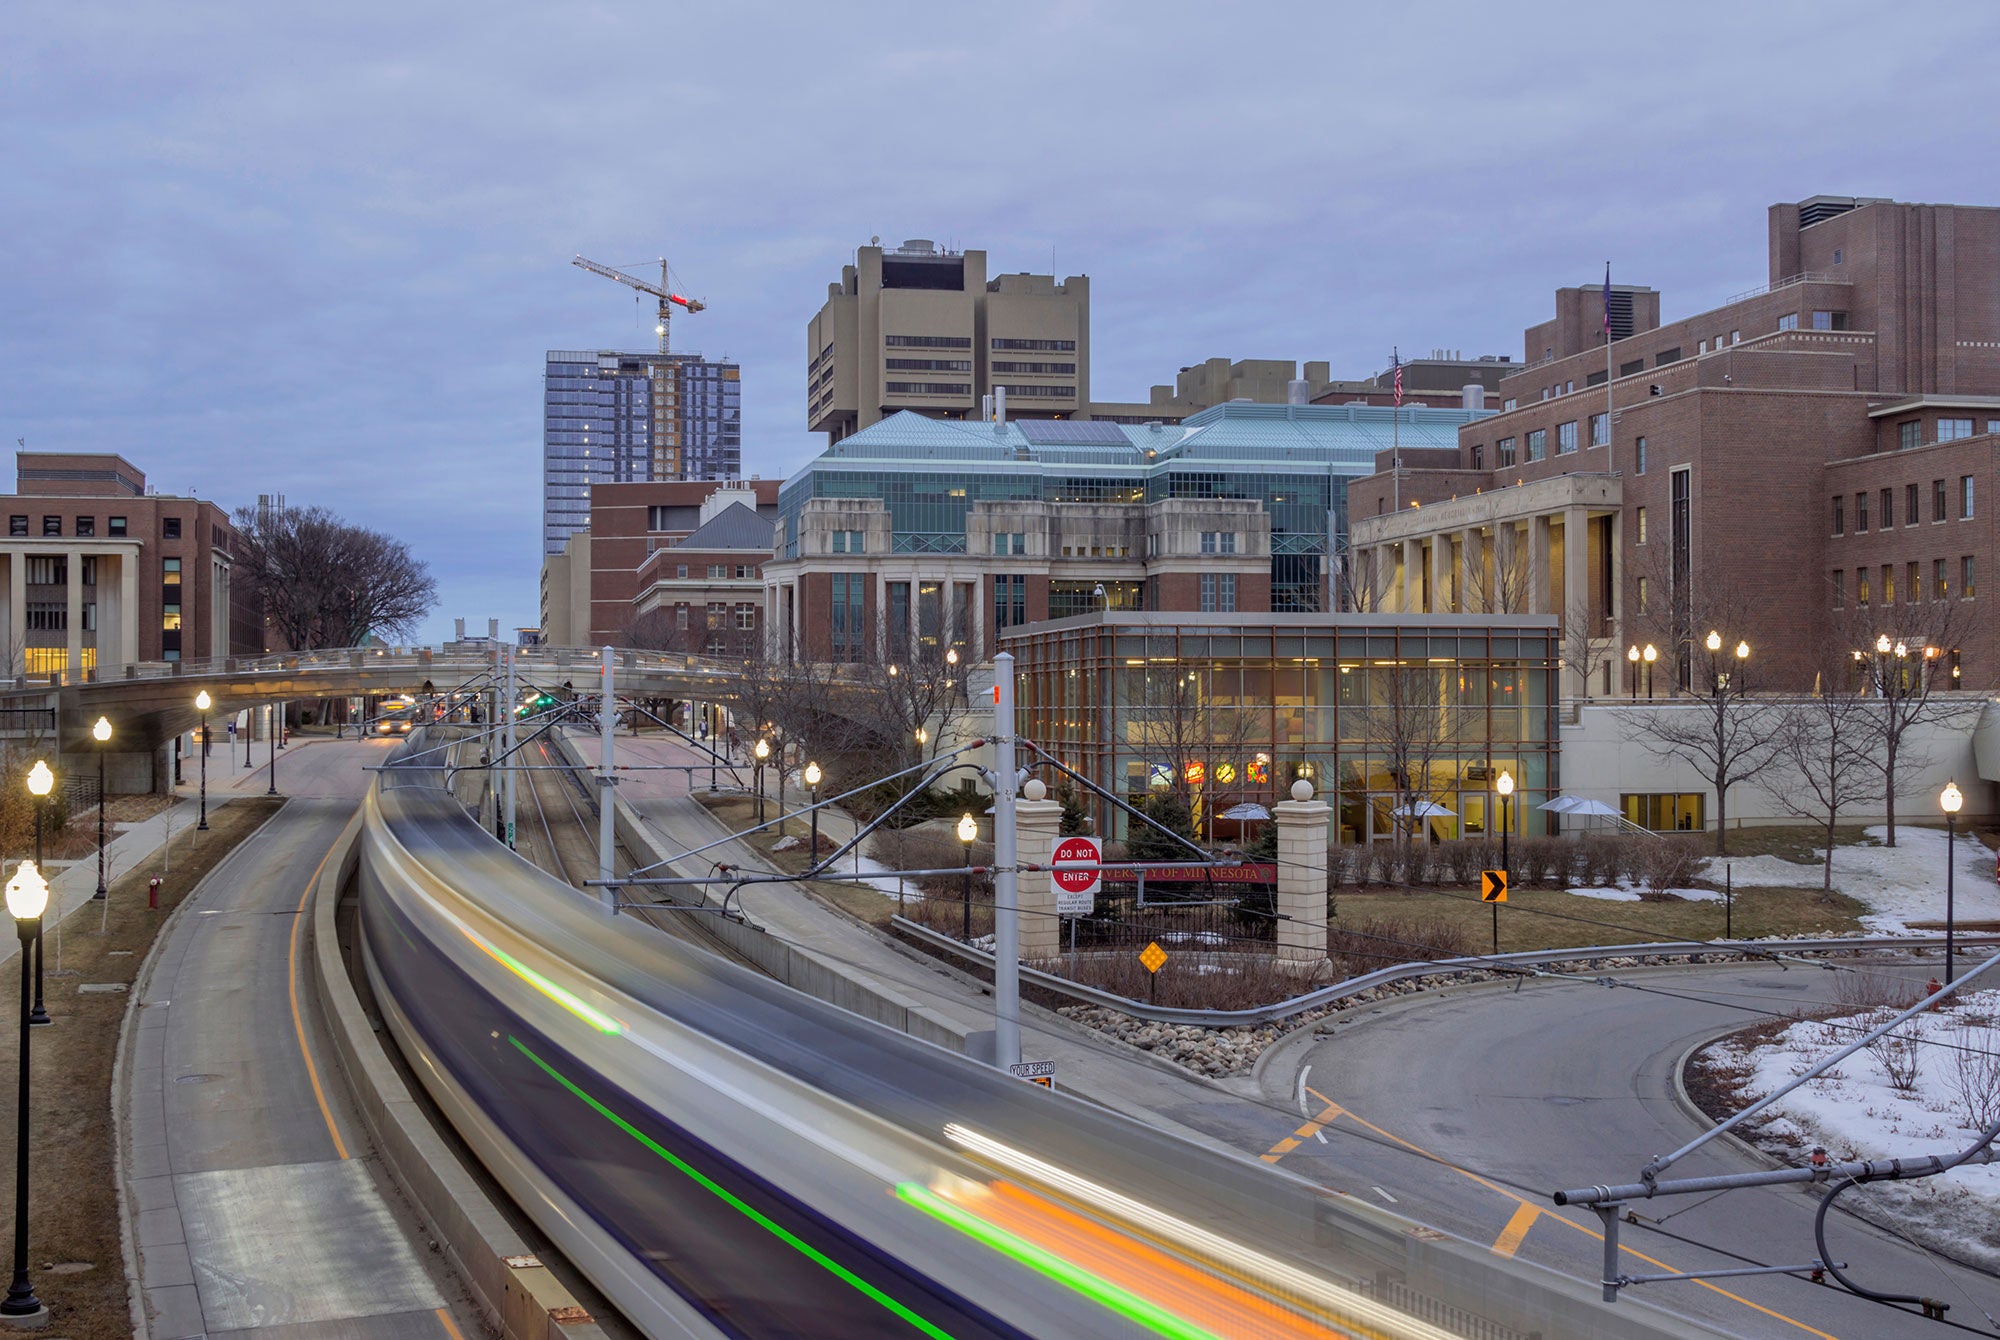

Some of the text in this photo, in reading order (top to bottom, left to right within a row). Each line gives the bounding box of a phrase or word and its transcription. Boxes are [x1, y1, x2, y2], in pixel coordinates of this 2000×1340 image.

[1060, 849, 1093, 859] DO NOT
[1062, 872, 1089, 882] ENTER
[1162, 867, 1178, 879] OF
[1183, 867, 1258, 880] MINNESOTA
[1011, 1062, 1053, 1076] YOUR SPEED
